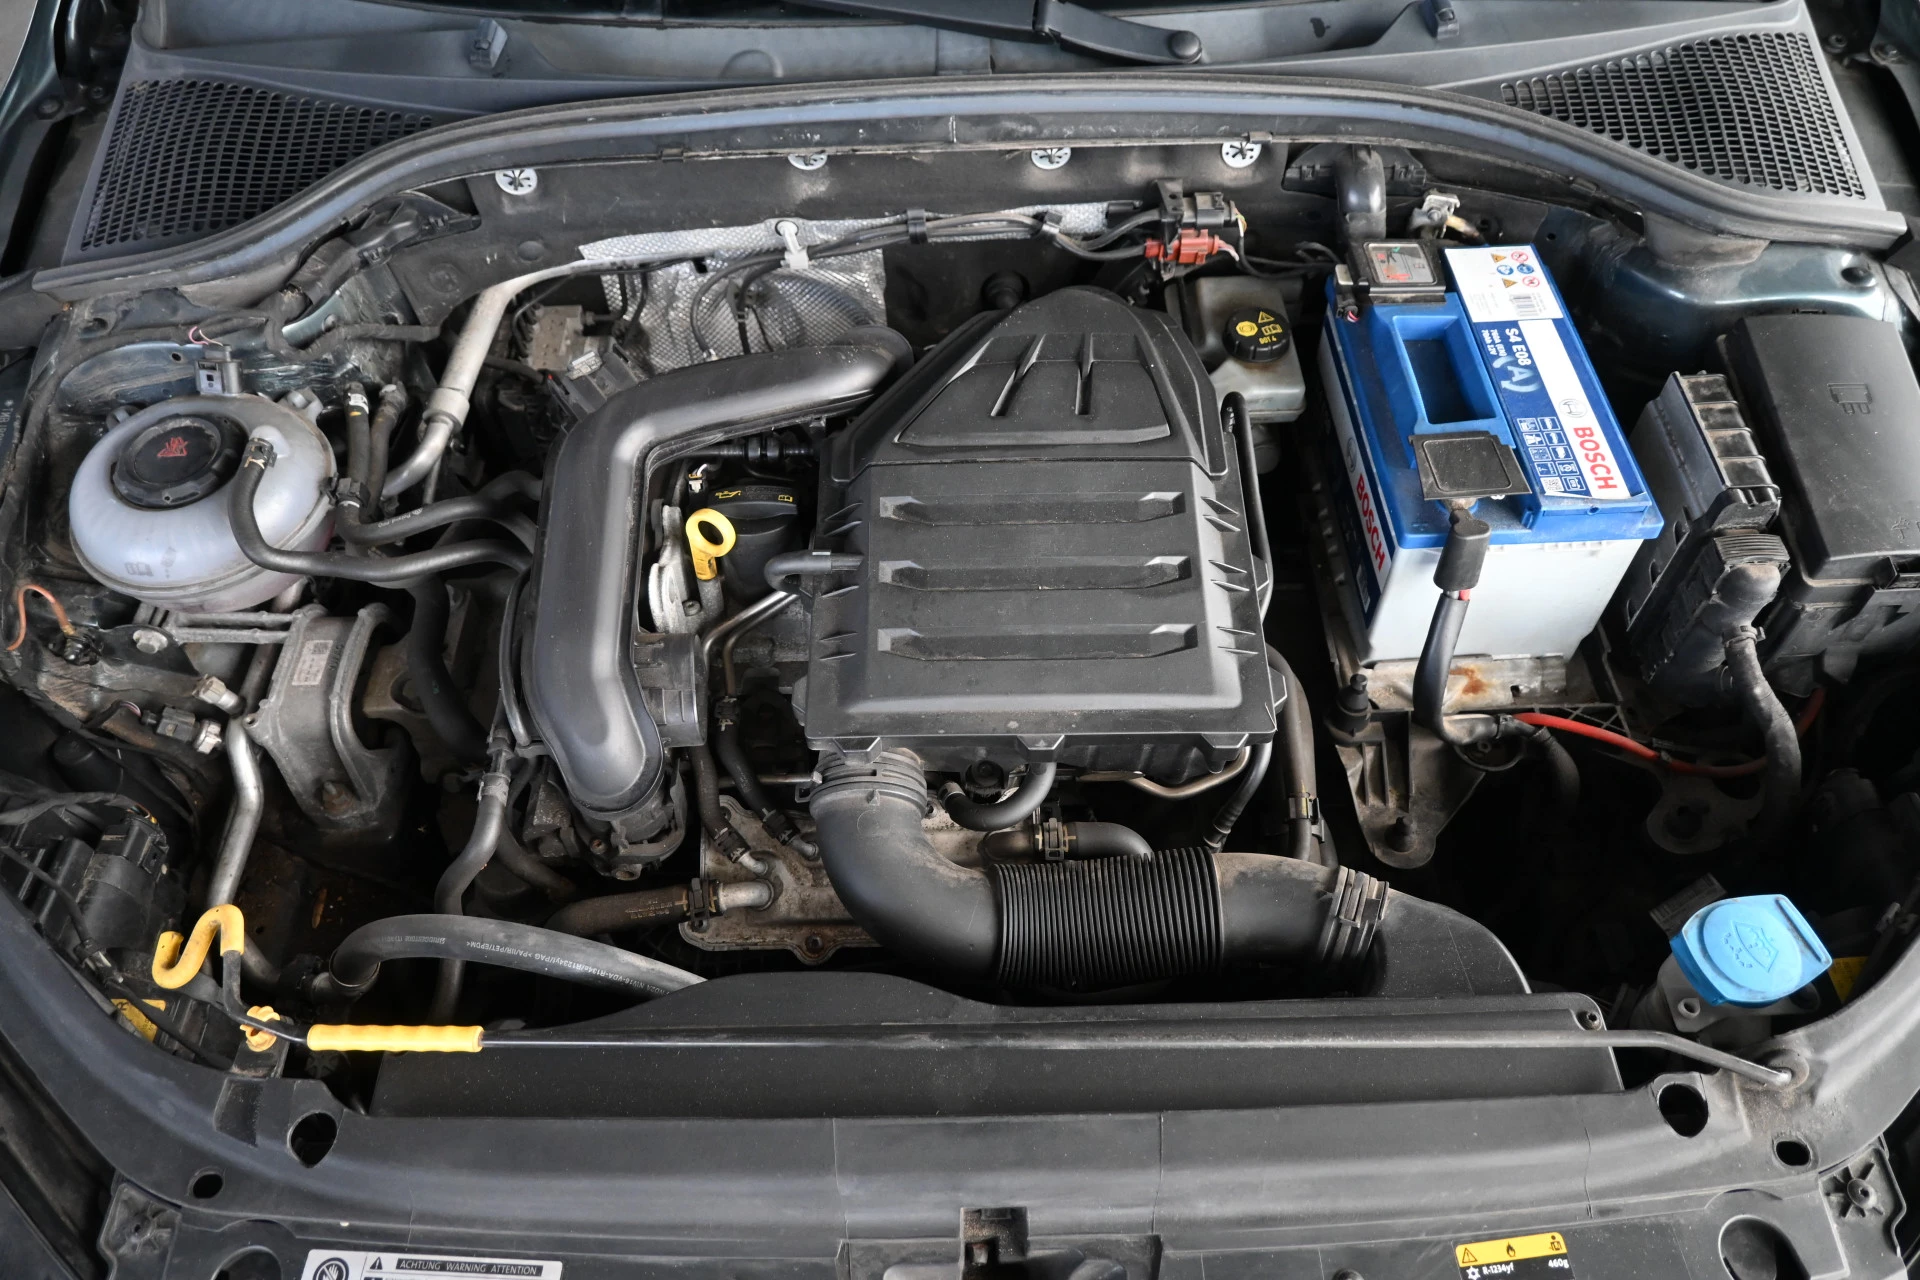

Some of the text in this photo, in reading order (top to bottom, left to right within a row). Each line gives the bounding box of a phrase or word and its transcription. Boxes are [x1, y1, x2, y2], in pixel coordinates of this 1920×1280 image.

[1505, 328, 1532, 366] S4 E08
[1573, 427, 1618, 489] BOSCH
[1356, 473, 1386, 572] BOSCH
[400, 1260, 537, 1276] ACHTUNG WARNING ATTENTION
[1482, 1258, 1569, 1275] R-1234yf 460g
